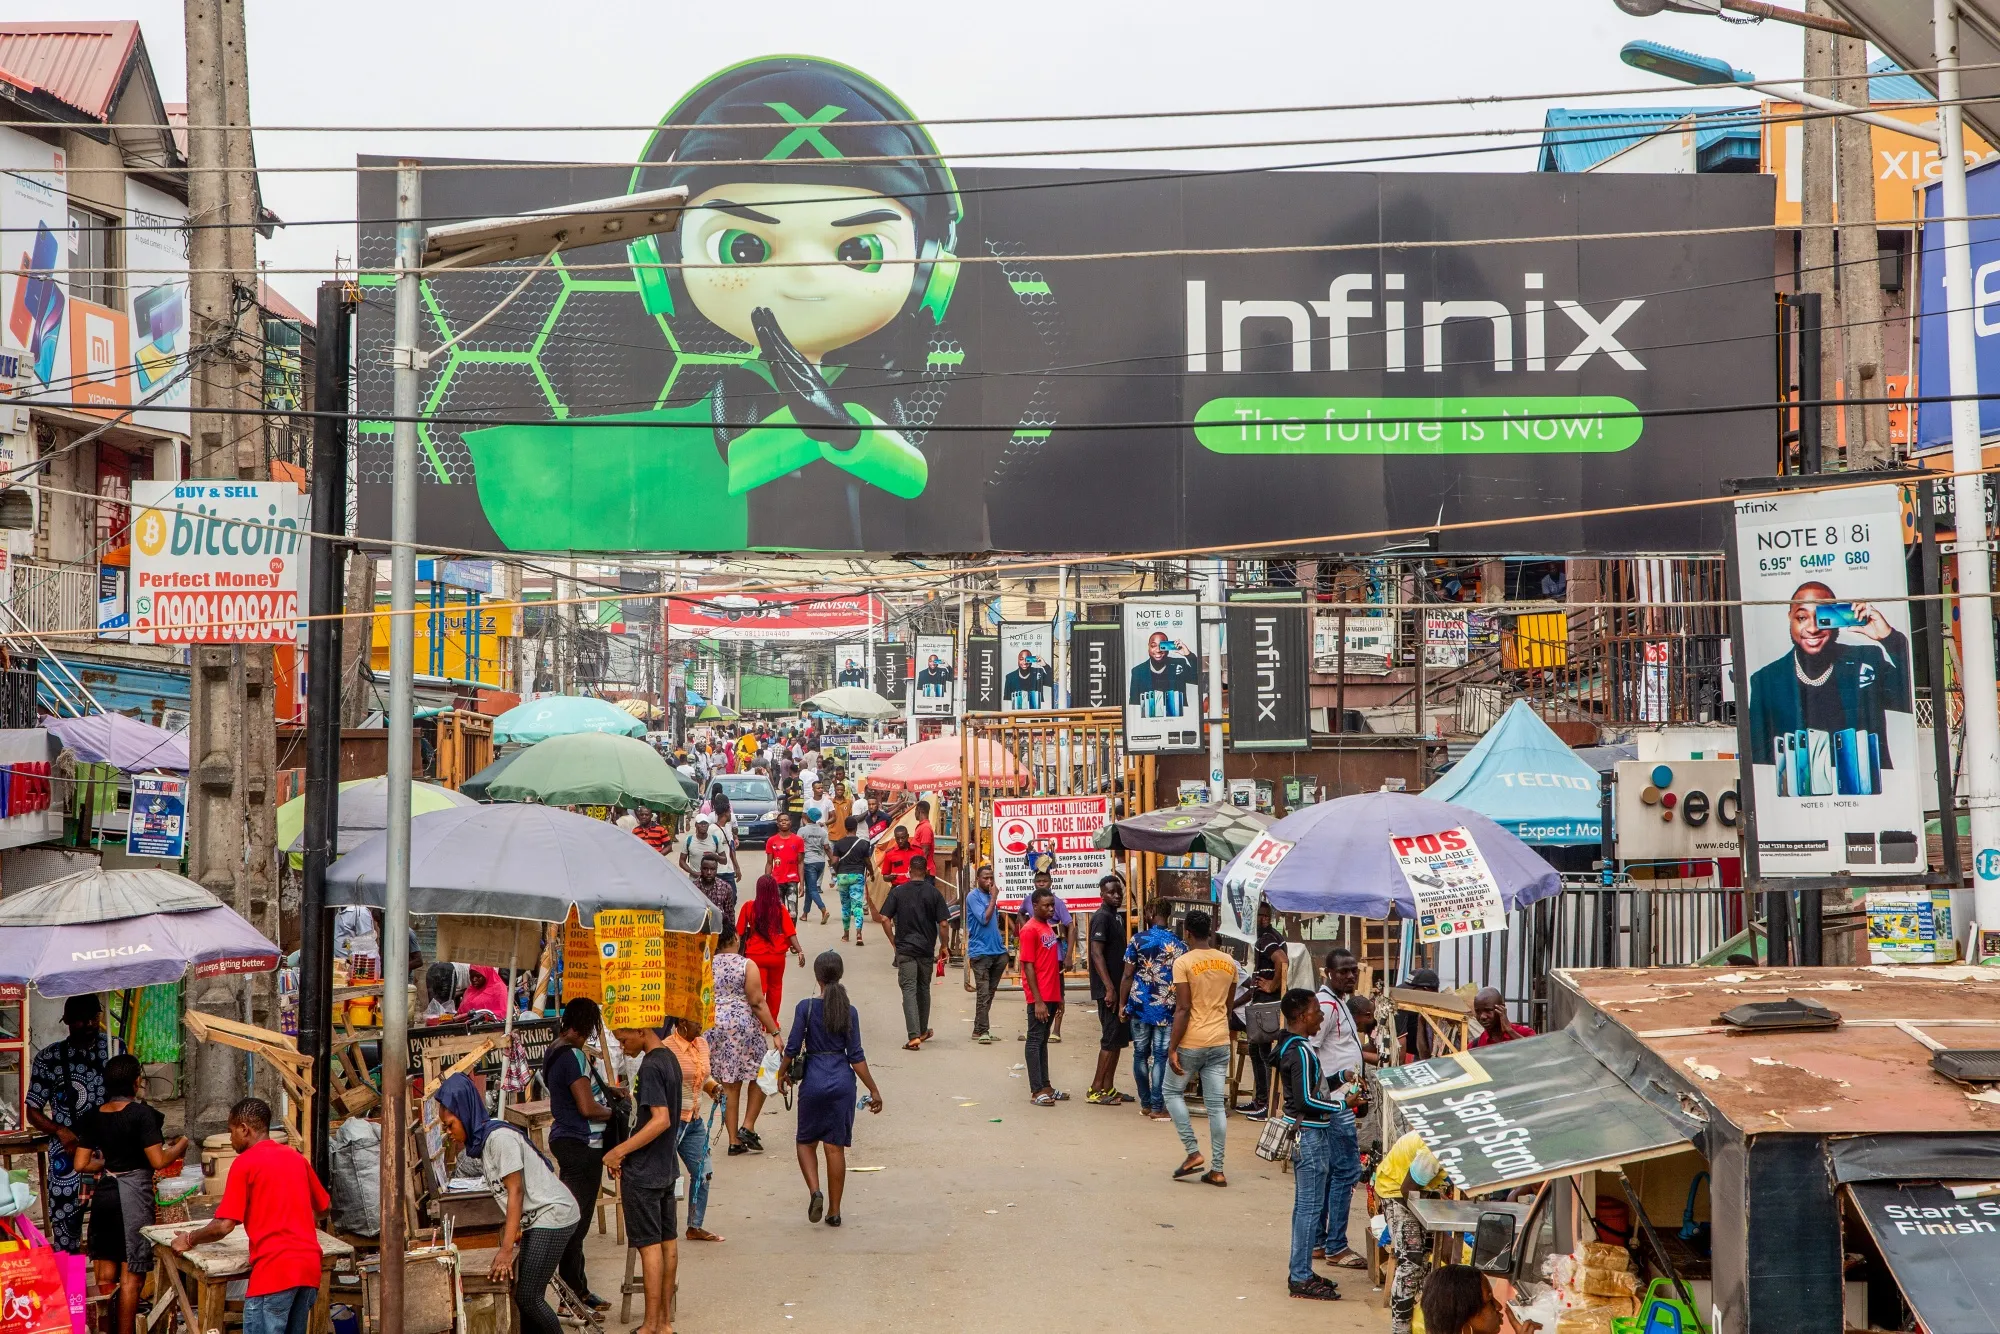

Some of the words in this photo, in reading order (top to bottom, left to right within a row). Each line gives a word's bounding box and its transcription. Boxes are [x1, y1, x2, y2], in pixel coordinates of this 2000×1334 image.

[1186, 273, 1647, 373] Infinix
[1234, 409, 1305, 441] The
[1324, 408, 1442, 442] future
[1460, 409, 1485, 441] is
[1502, 410, 1604, 441] Now!
[175, 486, 205, 498] BUY
[209, 486, 220, 498] &
[224, 486, 258, 498] SELL
[170, 503, 297, 556] bitcoin
[1757, 527, 1818, 550] NOTE
[1825, 526, 1838, 545] 8
[1851, 523, 1870, 543] 8i
[1759, 556, 1792, 571] 6.95"
[1800, 553, 1836, 568] 64MP
[1845, 550, 1870, 564] G80
[139, 572, 211, 588] Perfect
[215, 571, 280, 588] Money
[809, 601, 860, 610] HIKVISION
[1136, 610, 1162, 619] NOTE
[1164, 610, 1170, 618] 8
[1175, 609, 1184, 618] 8i
[1427, 620, 1465, 629] UNLOCK
[1428, 629, 1464, 639] FLASH
[885, 653, 897, 694] Infinix
[980, 650, 993, 702] Infinix
[1255, 617, 1282, 721] Infinix
[139, 780, 156, 790] POS
[914, 782, 937, 790] Battery
[1497, 772, 1592, 791] TECNO
[1001, 803, 1030, 817] NOTICE!
[1032, 802, 1063, 815] NOTICE!!
[1065, 801, 1100, 814] NOTICE!!!
[1037, 817, 1049, 832] NO
[1052, 816, 1073, 832] FACE
[1077, 815, 1104, 831] MASK
[1518, 822, 1571, 841] Expect
[1062, 836, 1094, 850] ENTR
[1392, 830, 1467, 857] POS
[1400, 857, 1411, 865] IS
[1414, 848, 1475, 864] AVAILABLE
[1418, 889, 1445, 898] MONEY
[1448, 883, 1489, 894] TRANSFER
[1420, 893, 1458, 903] WITHDRAWAL
[1466, 887, 1490, 897] DEPOSIT
[1444, 898, 1463, 906] YOUR
[1465, 895, 1485, 903] BILLS
[1421, 906, 1455, 916] AIRTIME,
[1456, 902, 1475, 910] DATA
[600, 915, 617, 926] BUY
[620, 914, 634, 925] ALL
[637, 913, 661, 924] YOUR
[601, 927, 635, 939] RECHARGE
[637, 925, 662, 938] CARDS
[645, 939, 661, 948] 200
[71, 943, 154, 962] NOKIA
[644, 948, 662, 957] 500
[241, 958, 266, 968] better.
[642, 960, 662, 968] 200
[1191, 960, 1209, 976] PALM
[1210, 959, 1235, 976] ANGELS
[641, 970, 662, 979] 1000
[641, 983, 661, 991] 200
[641, 993, 661, 1002] 1000
[639, 1004, 660, 1013] 200
[614, 1015, 630, 1025] 500
[640, 1014, 662, 1023] 1000
[1443, 1090, 1516, 1135] Start
[1884, 1204, 1974, 1219] Start
[1894, 1219, 1997, 1236] Finish
